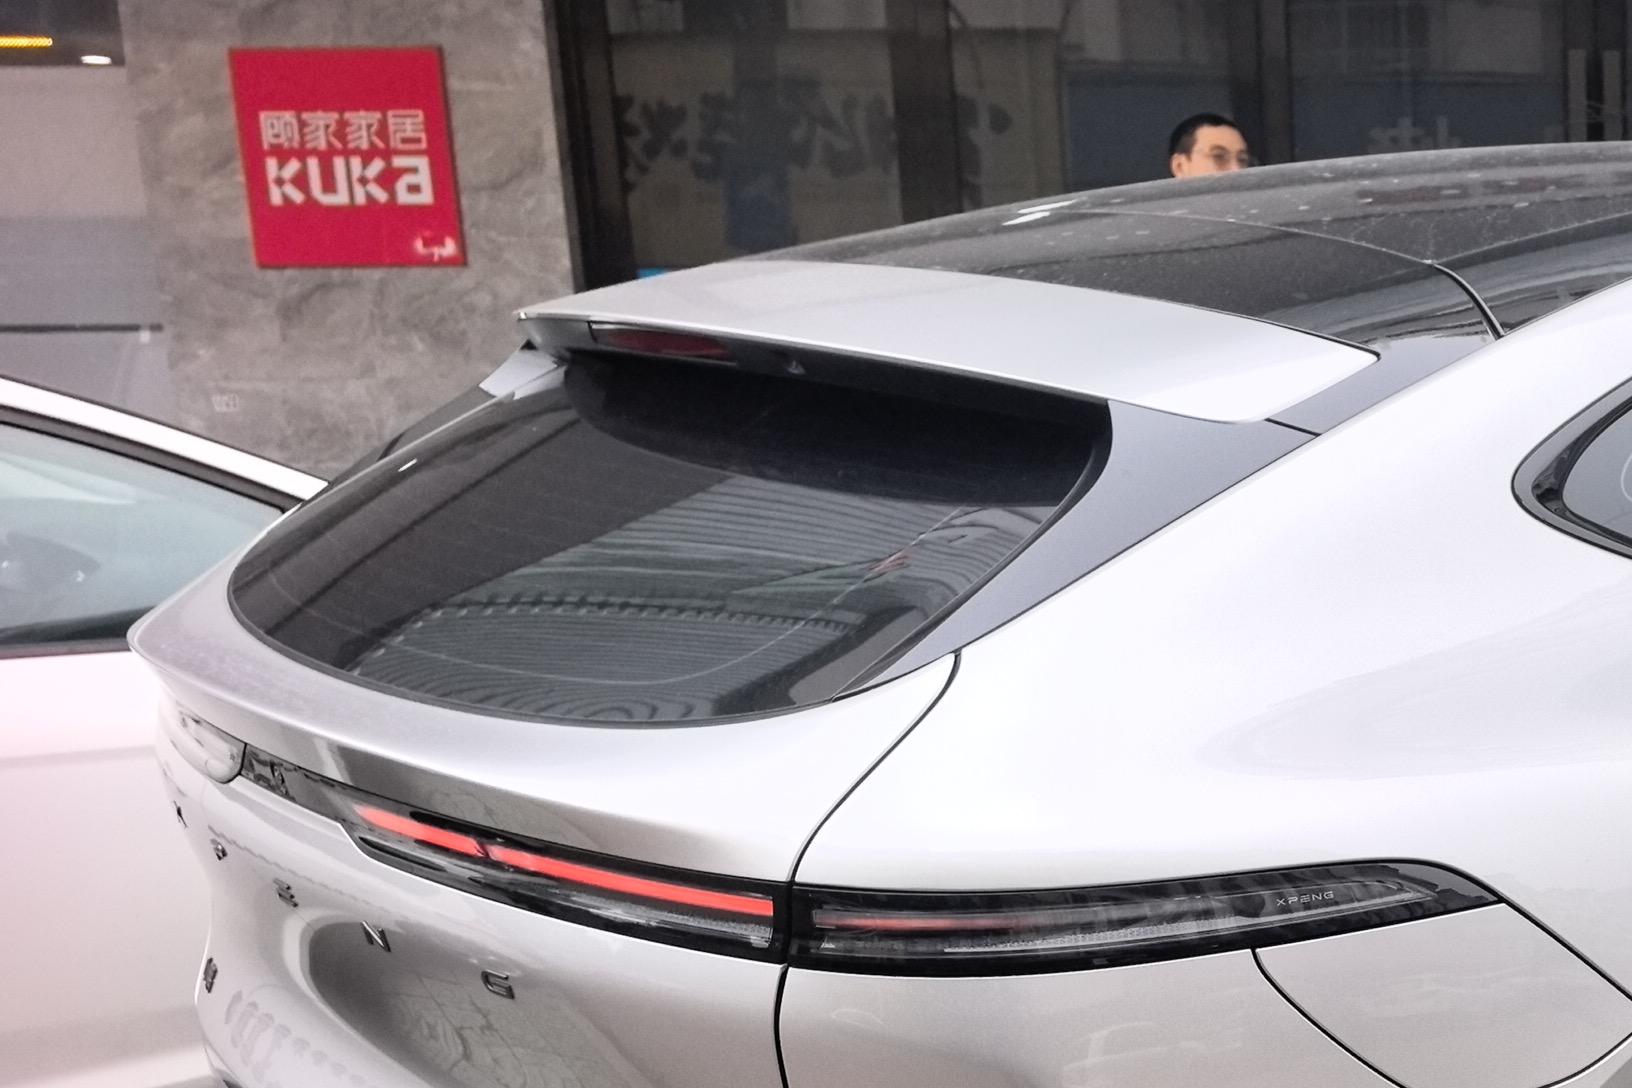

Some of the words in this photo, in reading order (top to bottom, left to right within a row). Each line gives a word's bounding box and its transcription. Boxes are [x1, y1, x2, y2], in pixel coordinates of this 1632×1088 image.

[258, 109, 429, 151] 顾家家居
[1275, 890, 1334, 907] XPENG
